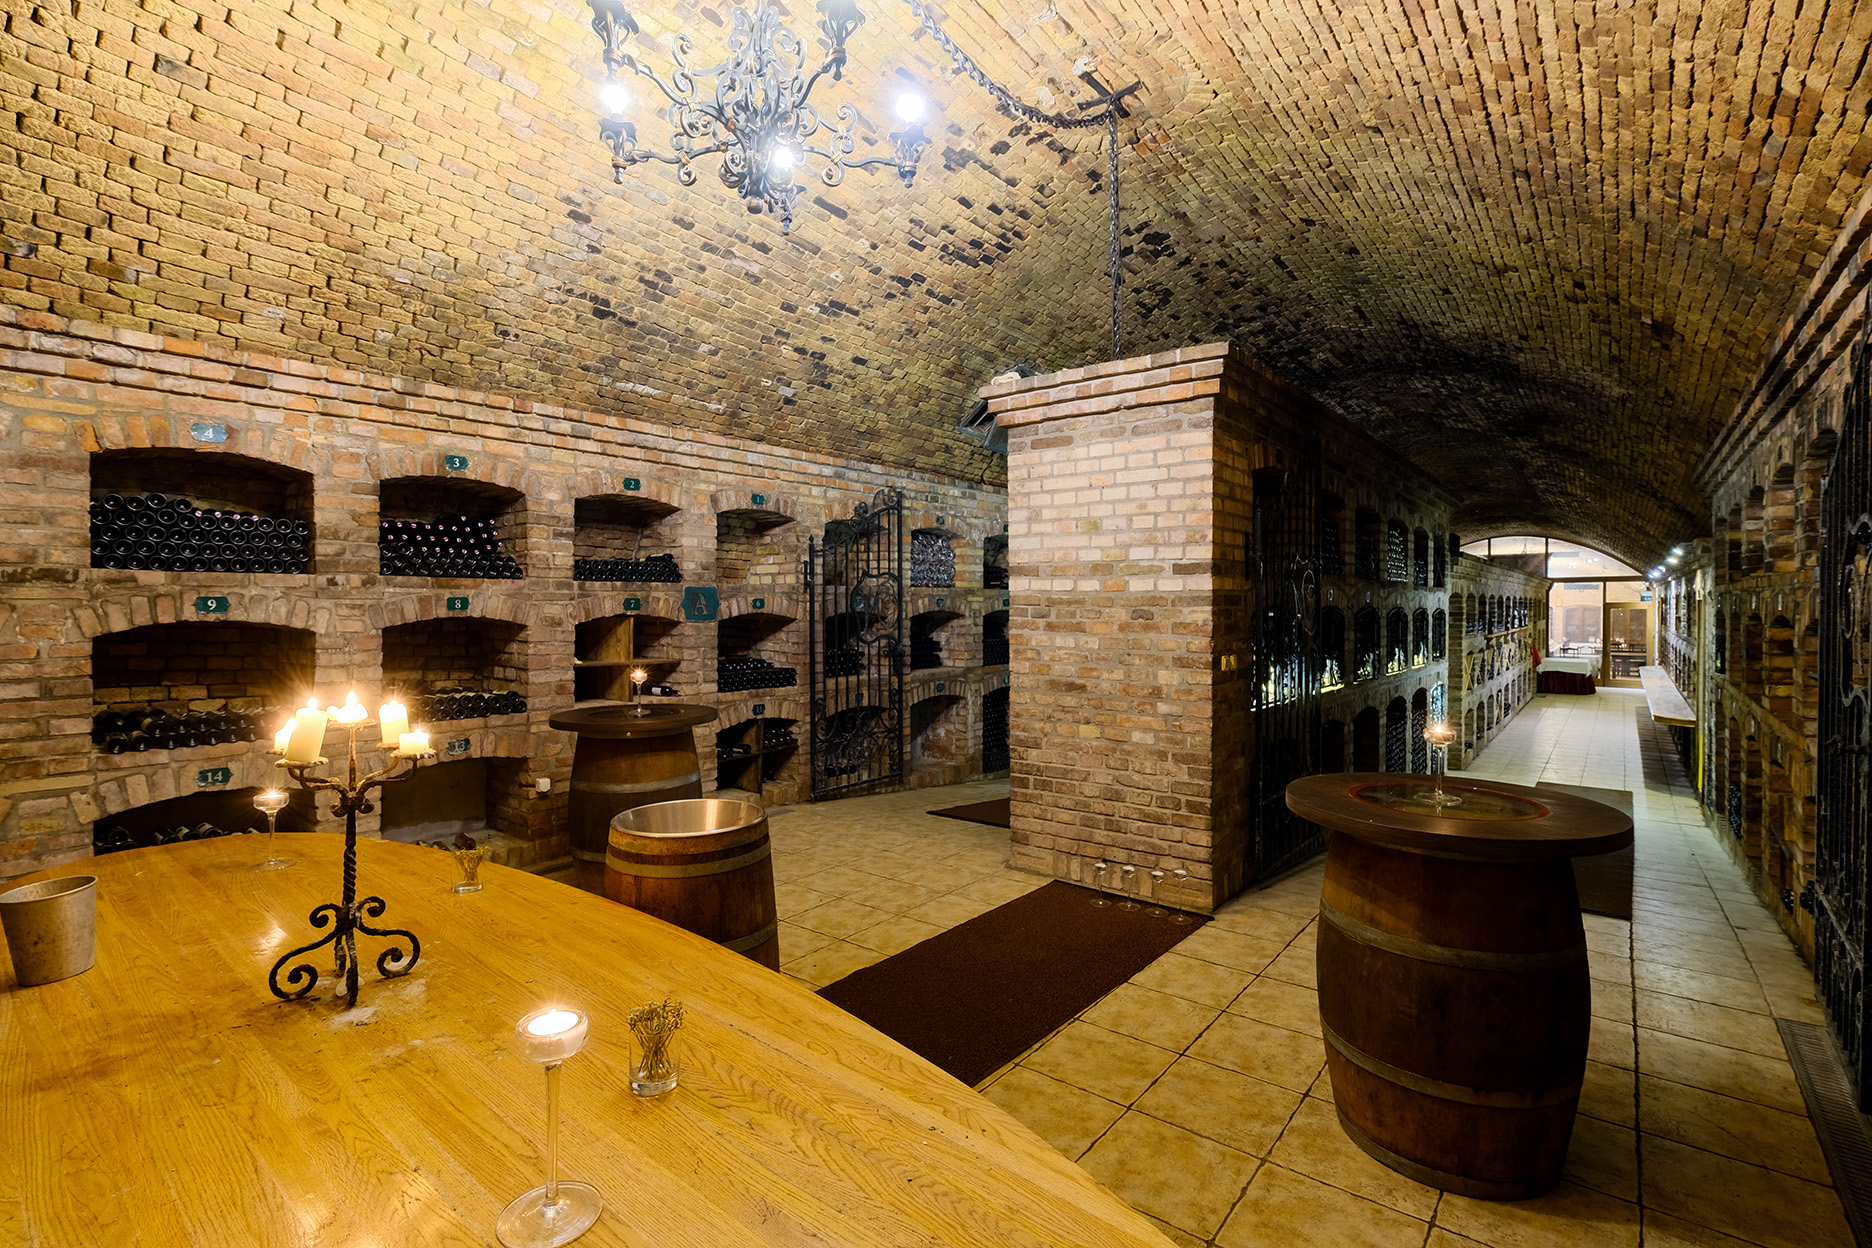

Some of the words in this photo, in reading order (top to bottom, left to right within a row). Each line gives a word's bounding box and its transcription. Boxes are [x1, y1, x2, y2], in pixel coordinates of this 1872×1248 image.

[204, 428, 214, 439] 4
[453, 458, 460, 467] 3
[629, 480, 635, 488] 2
[207, 599, 217, 610] 9
[454, 599, 462, 609] 8
[206, 770, 223, 783] 14
